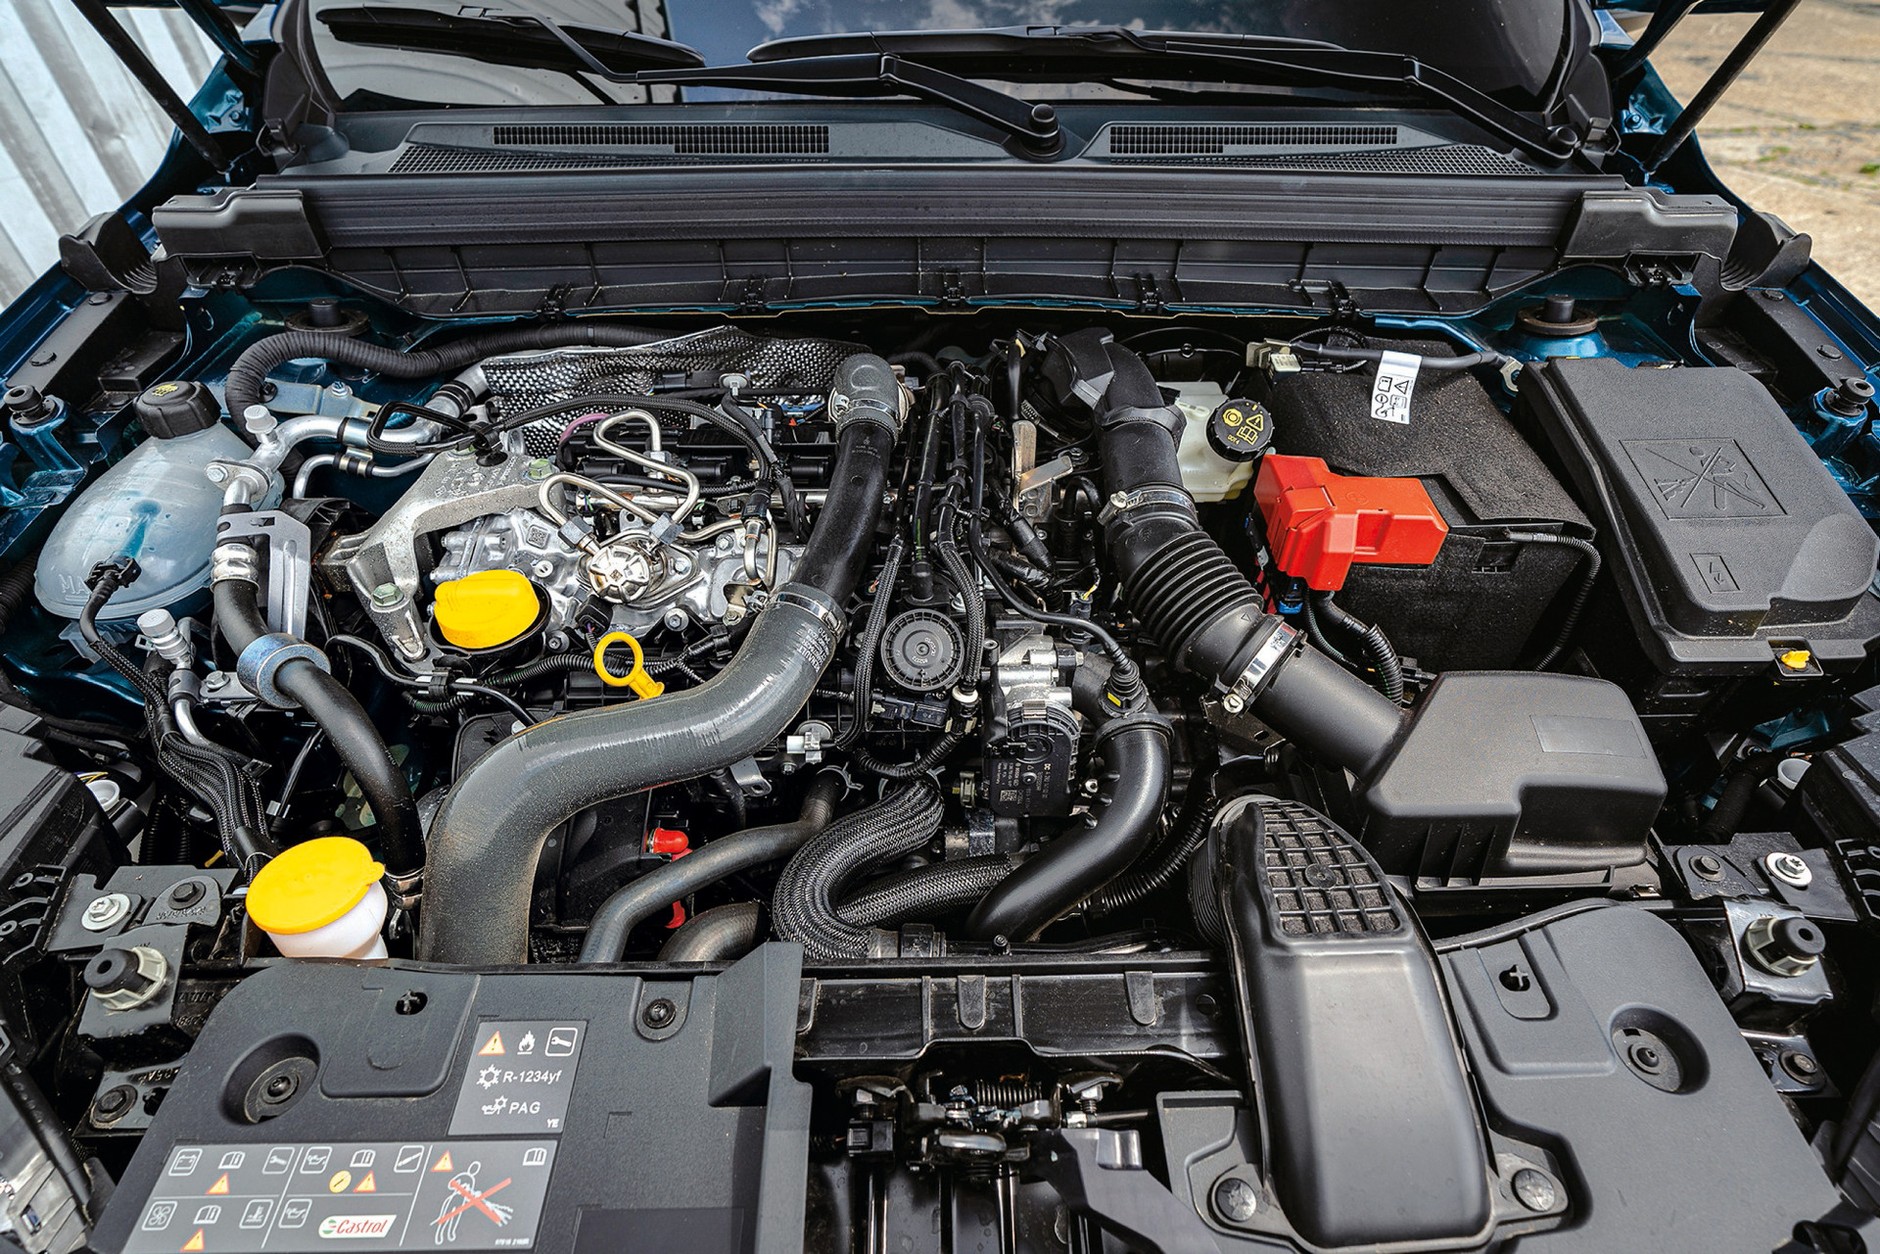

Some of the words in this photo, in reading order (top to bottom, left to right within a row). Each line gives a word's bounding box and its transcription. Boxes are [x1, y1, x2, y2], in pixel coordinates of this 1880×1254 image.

[58, 574, 90, 595] MA
[502, 1070, 562, 1085] R-1234yf
[509, 1101, 541, 1115] PAG
[546, 1119, 560, 1128] YE
[336, 1219, 388, 1234] Castrol
